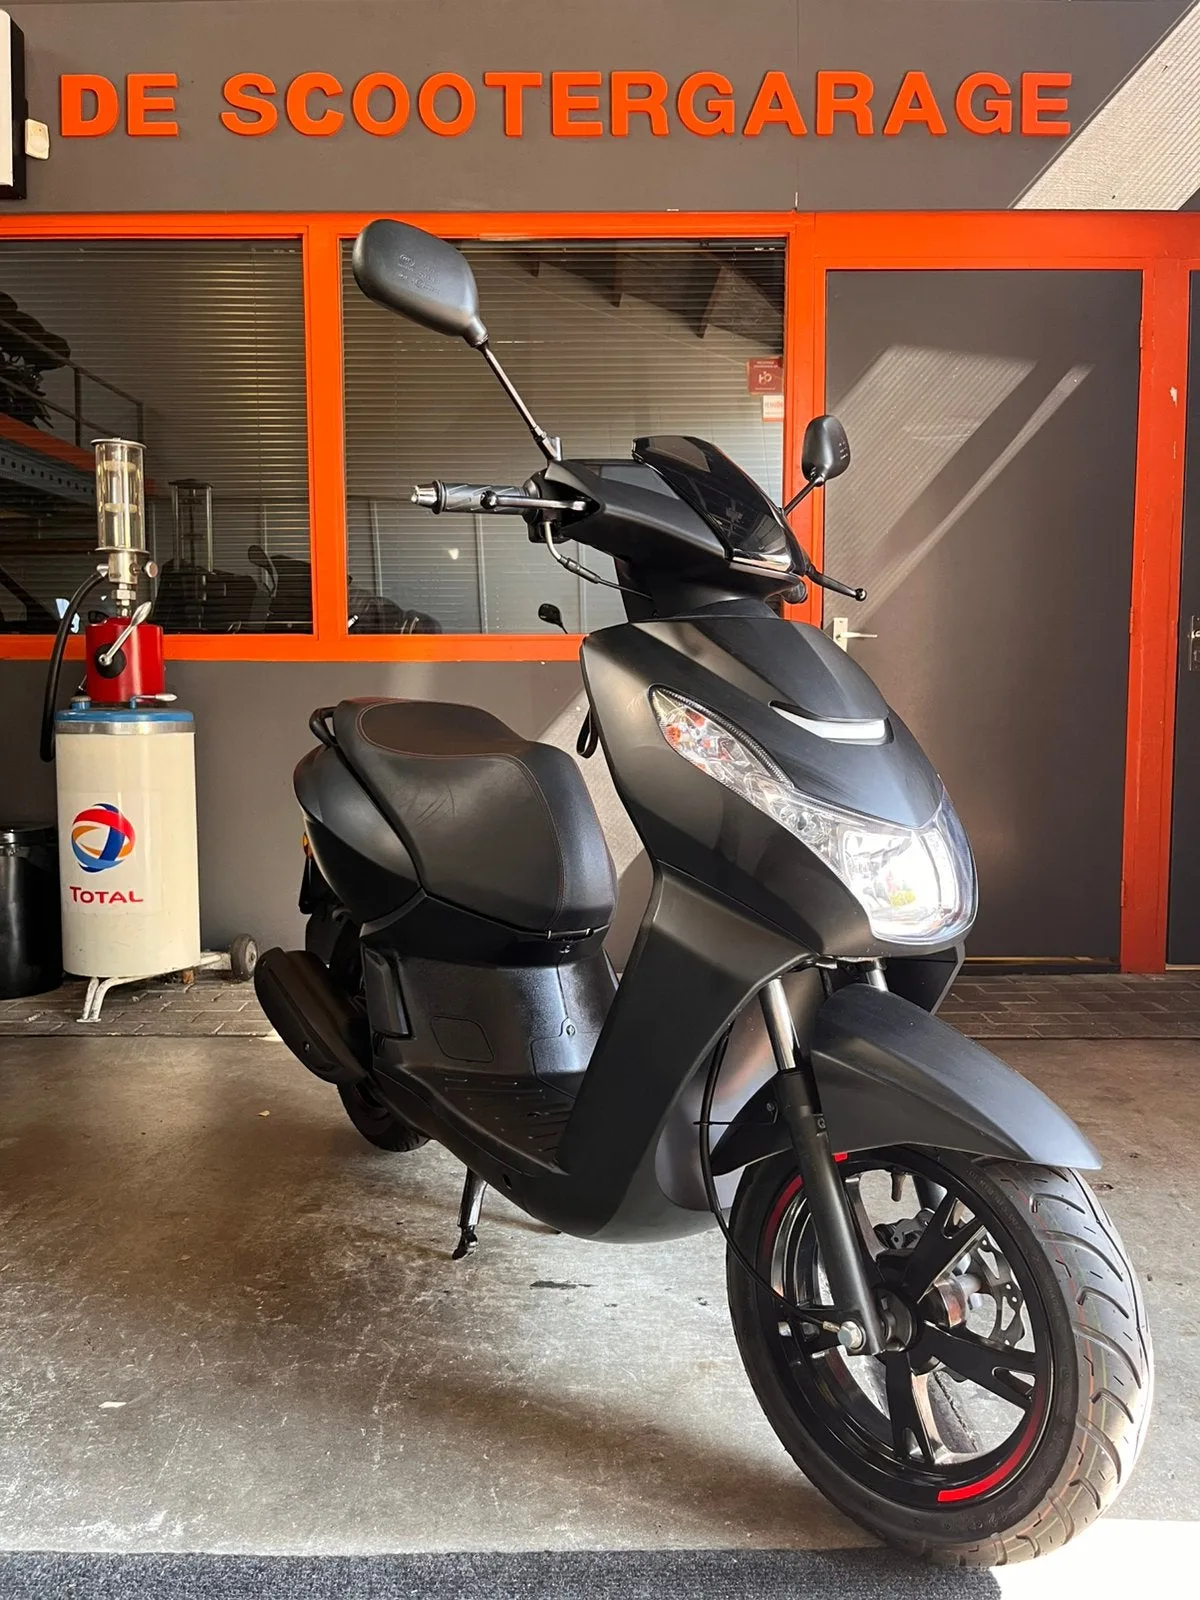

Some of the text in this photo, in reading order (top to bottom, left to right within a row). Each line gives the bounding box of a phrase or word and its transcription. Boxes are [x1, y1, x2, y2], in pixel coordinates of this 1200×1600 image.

[60, 71, 1072, 137] DE SCOOTERGARAGE
[69, 885, 144, 904] TOTAL
